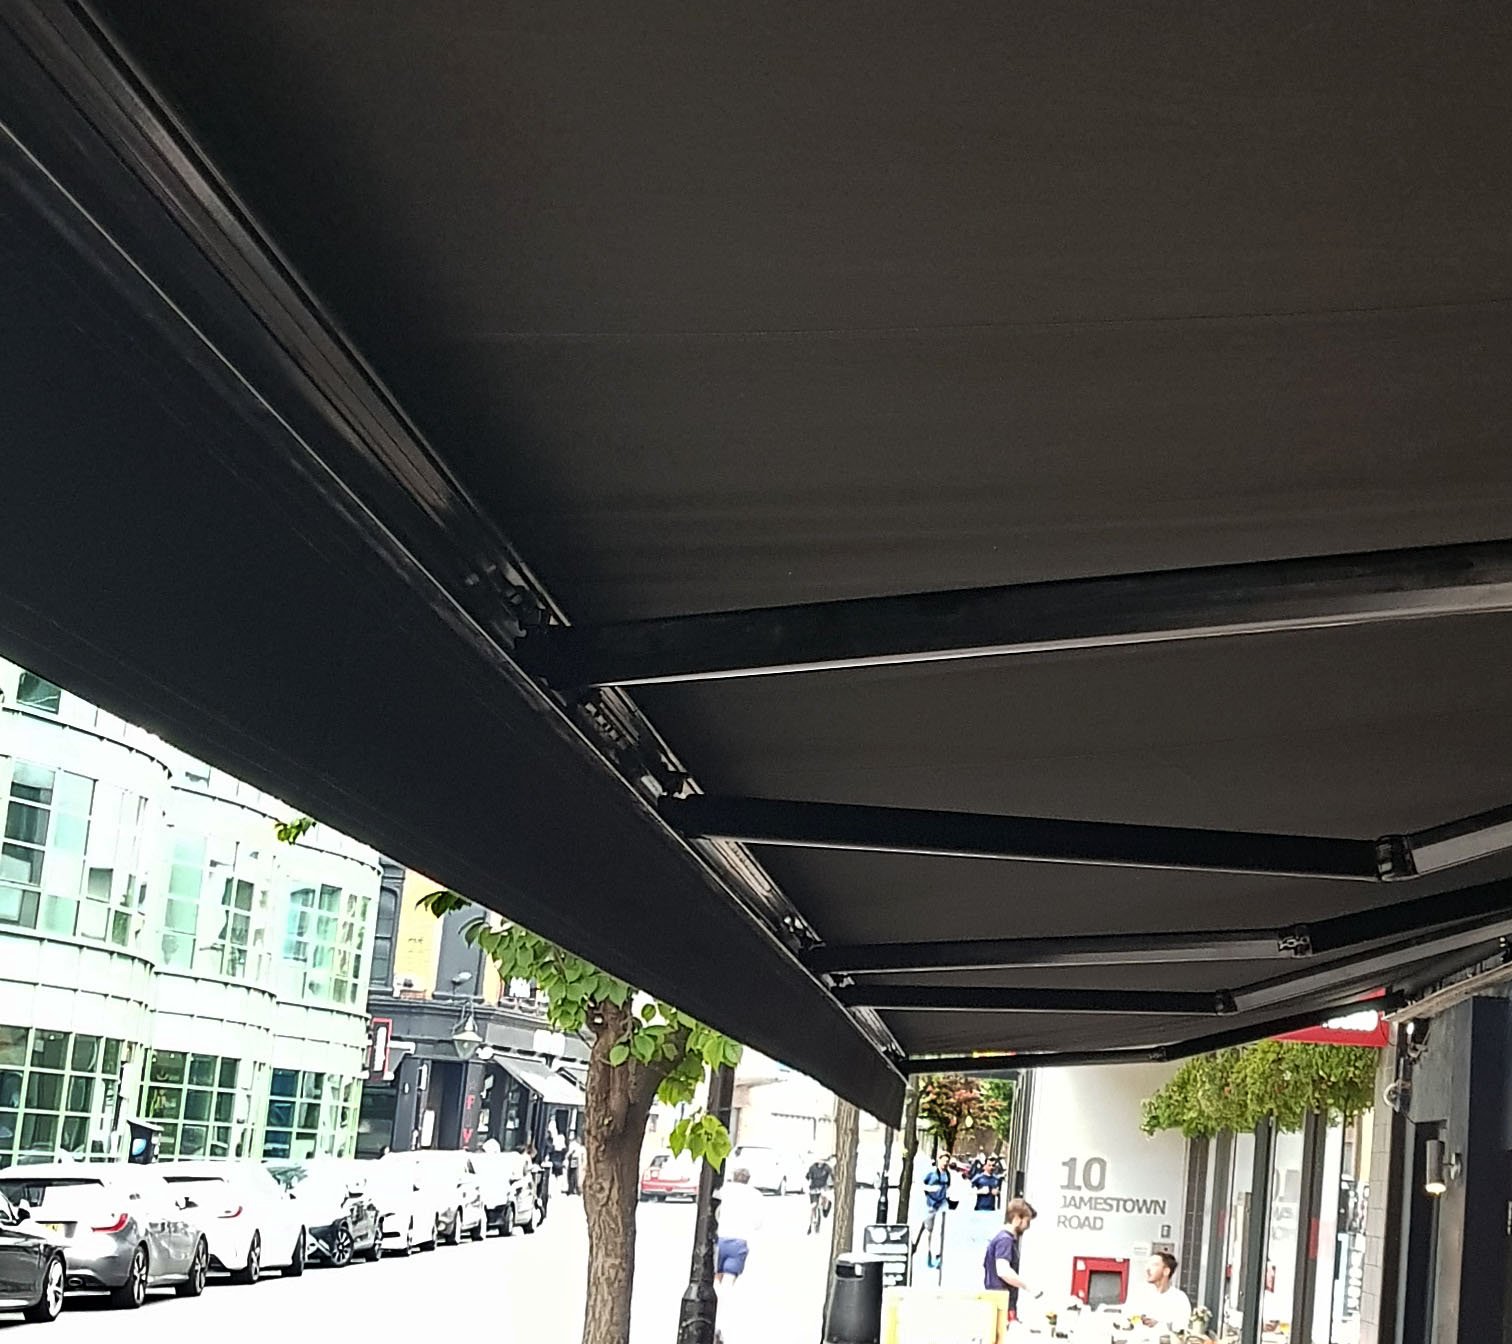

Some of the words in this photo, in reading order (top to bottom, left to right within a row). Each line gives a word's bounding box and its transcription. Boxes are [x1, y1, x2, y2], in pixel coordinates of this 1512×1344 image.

[1060, 1156, 1107, 1192] 10
[1060, 1195, 1167, 1215] JAMESTOWN
[1057, 1214, 1104, 1231] ROAD
